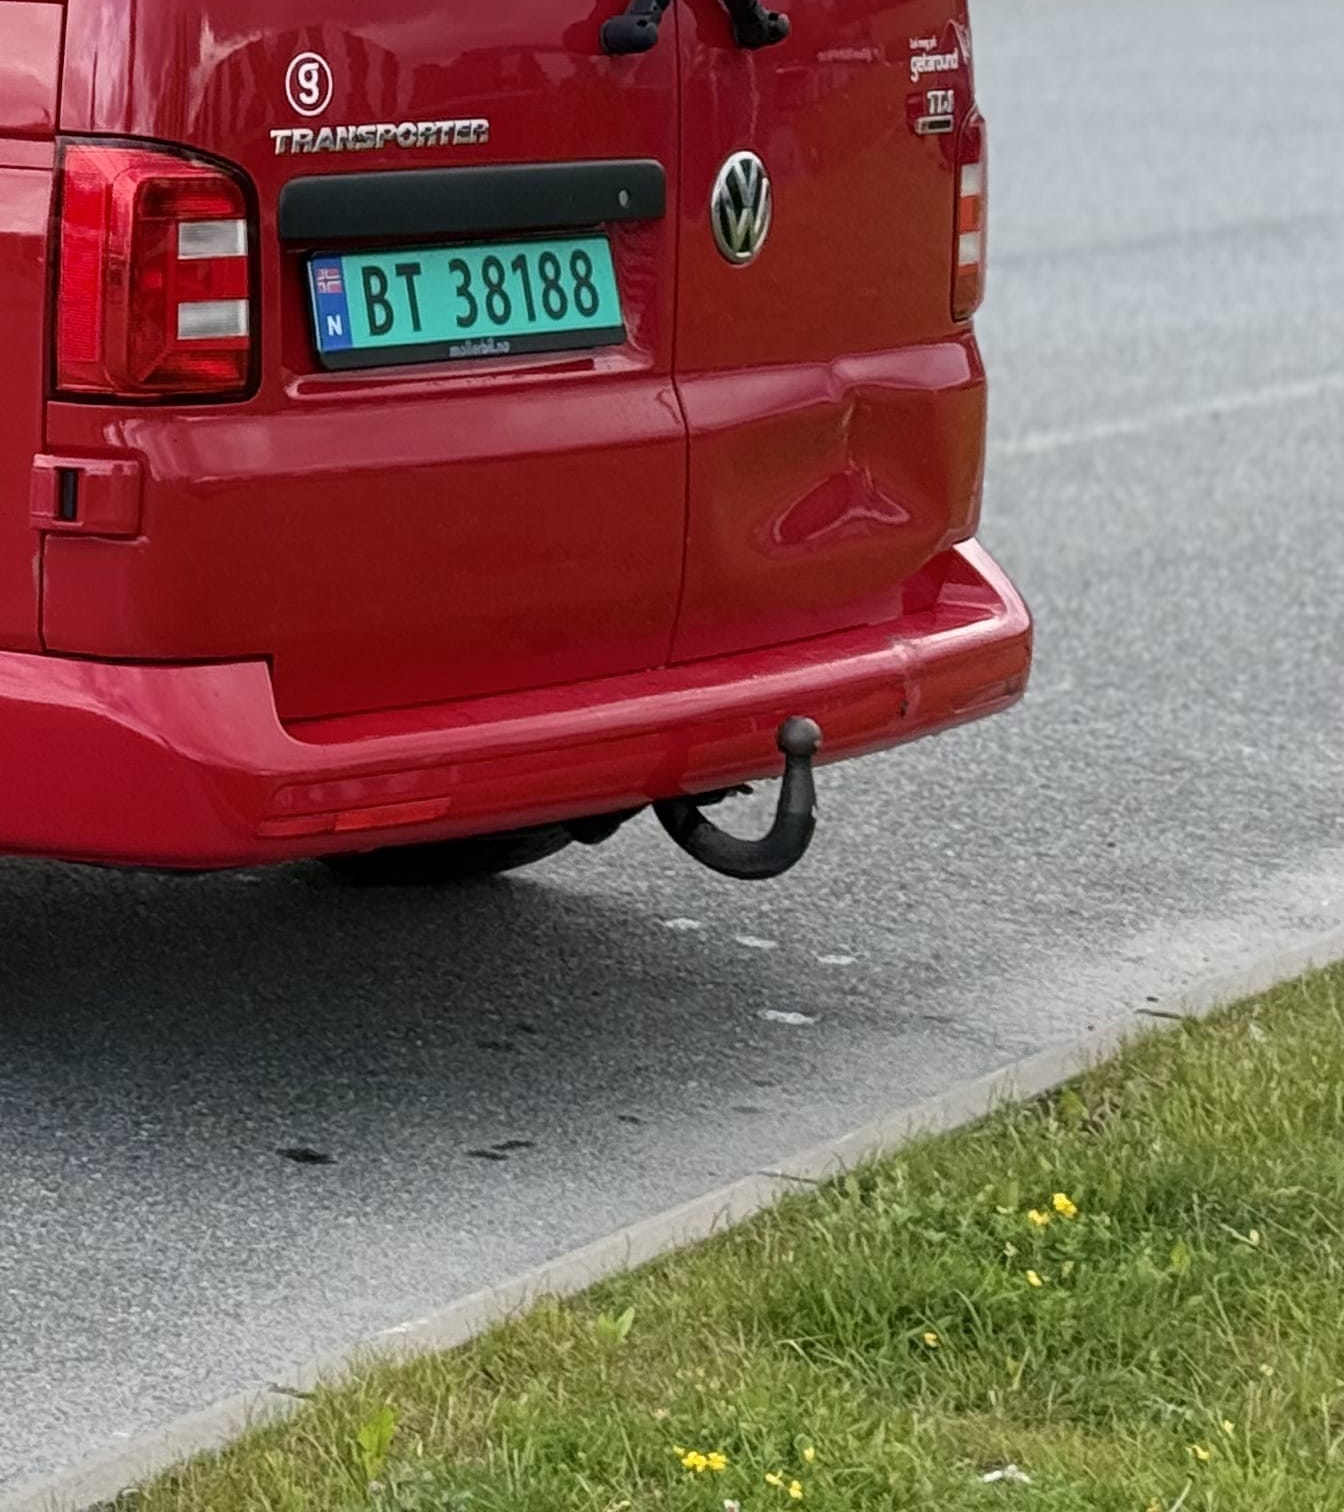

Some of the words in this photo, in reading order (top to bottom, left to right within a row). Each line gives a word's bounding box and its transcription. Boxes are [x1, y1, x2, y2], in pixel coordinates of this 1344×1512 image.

[270, 118, 490, 155] TRANSPORTER
[327, 315, 343, 336] N
[362, 262, 422, 337] BT
[448, 249, 600, 328] 38188
